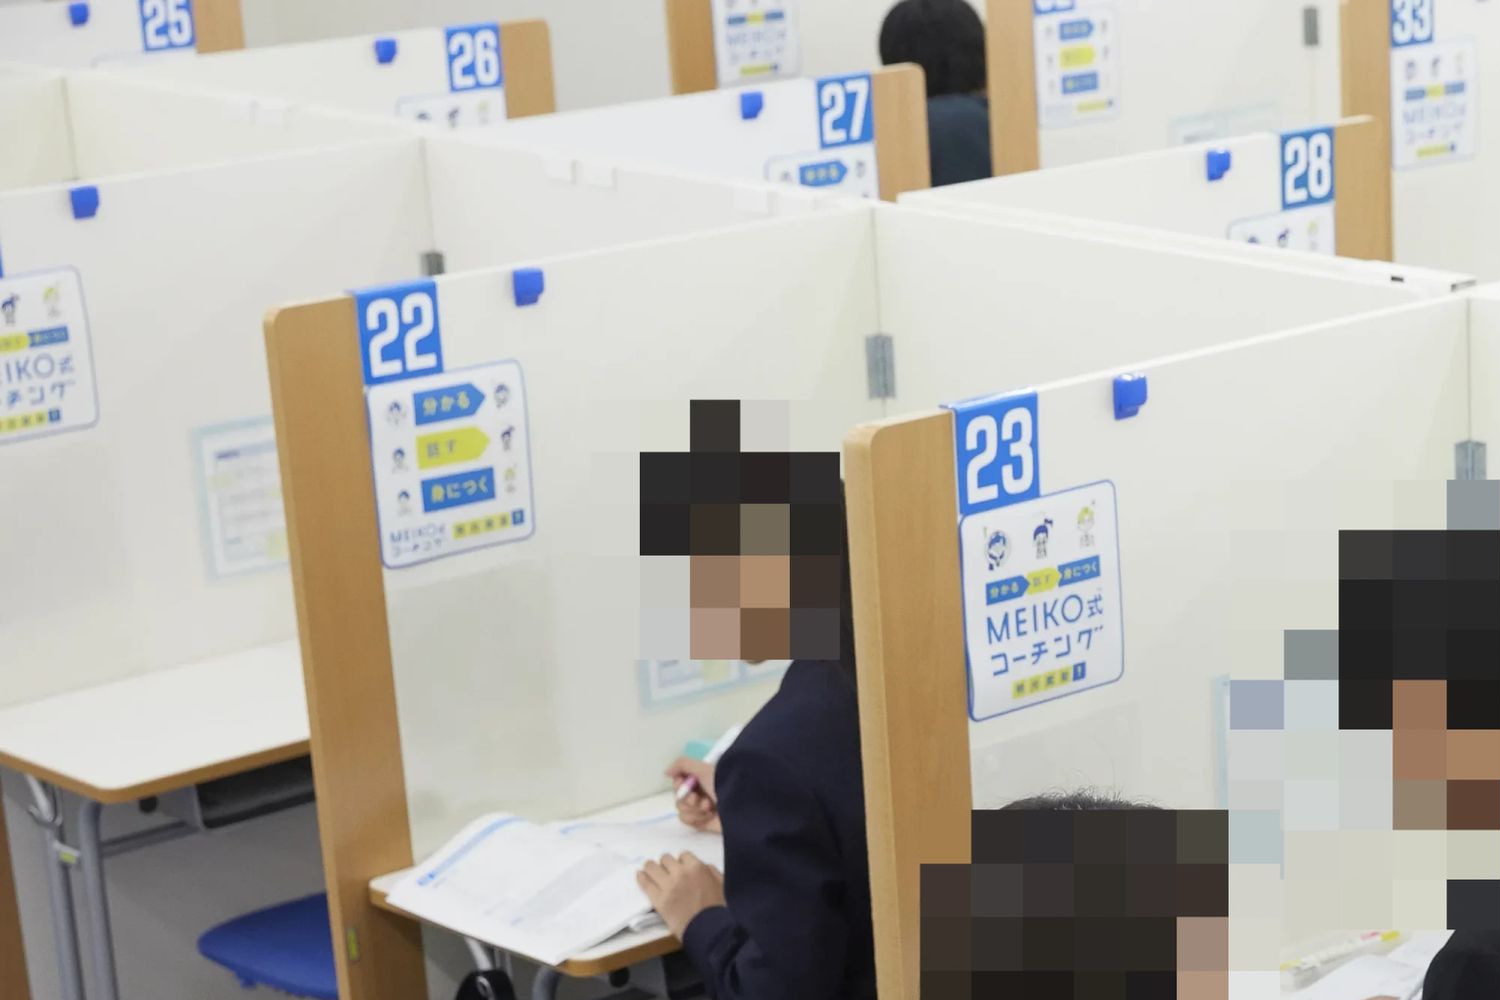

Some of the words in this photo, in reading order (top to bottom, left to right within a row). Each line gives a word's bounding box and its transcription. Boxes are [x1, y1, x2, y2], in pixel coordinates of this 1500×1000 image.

[143, 0, 193, 49] 25
[1392, 0, 1433, 45] 33
[449, 28, 500, 89] 26
[820, 78, 870, 145] 27
[1284, 132, 1332, 205] 28
[366, 292, 437, 378] 22
[965, 406, 1034, 505] 23
[986, 593, 1103, 645] MEIKO式
[991, 624, 1104, 677] コーチング
